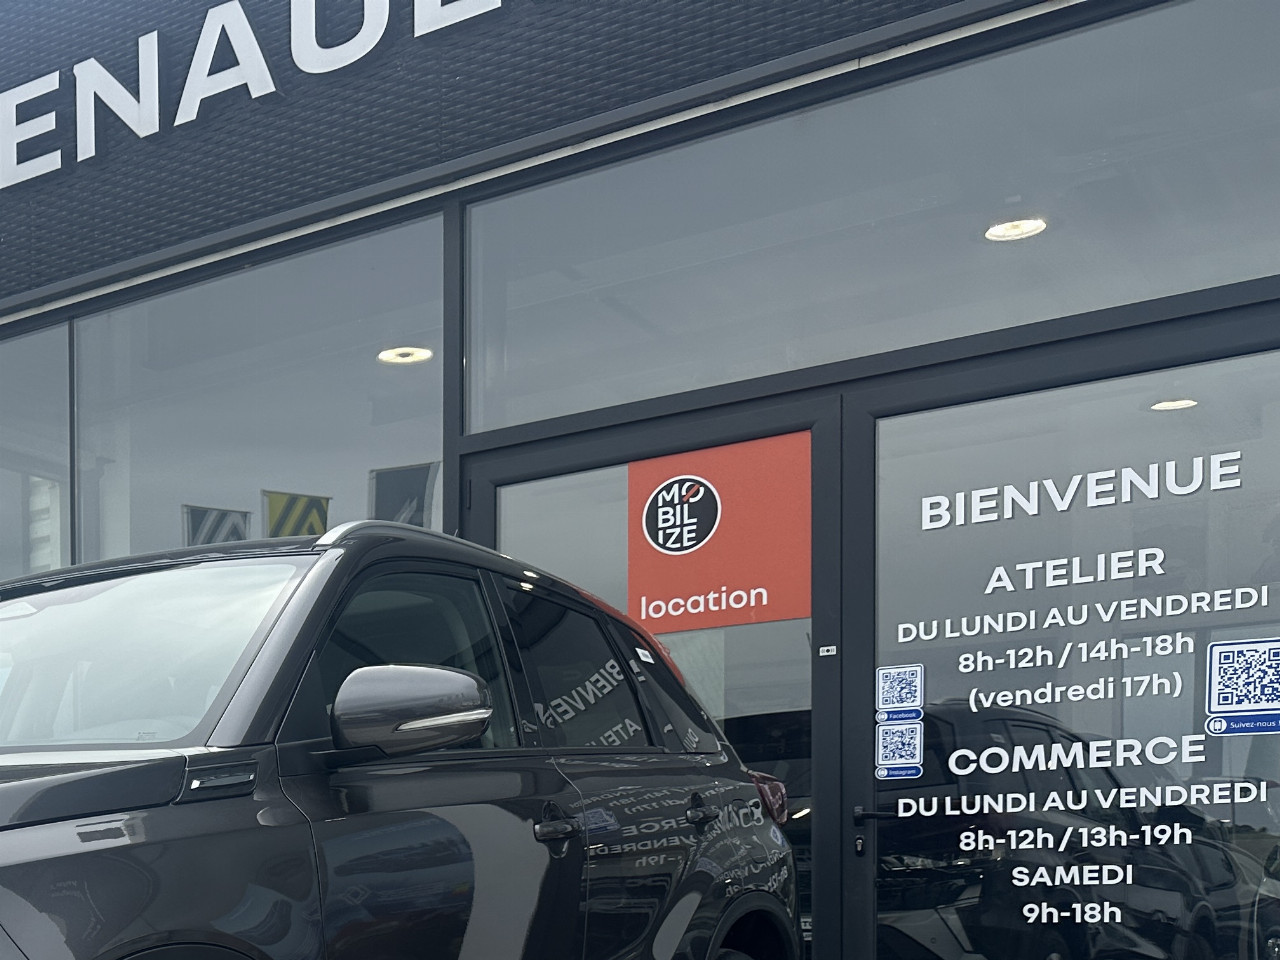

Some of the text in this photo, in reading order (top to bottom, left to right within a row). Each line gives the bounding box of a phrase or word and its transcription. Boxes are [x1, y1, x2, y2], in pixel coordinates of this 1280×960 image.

[921, 451, 1242, 531] BIENVENUE
[984, 548, 1166, 595] ATELIER
[641, 586, 769, 620] location
[897, 586, 1269, 643] DU LUNDI AU VENDREDI
[958, 643, 1053, 673] 8h-12h
[1078, 631, 1194, 664] 14h-18h
[969, 671, 1183, 713] (vendredi 17h)
[1229, 720, 1276, 729] Suivez-nous
[948, 734, 1206, 776] COMMERCE
[898, 782, 1267, 817] DU LUNDI AU VENDREDI
[959, 827, 1054, 852] 8h-12h
[1078, 822, 1193, 847] 13h-19h
[1012, 865, 1133, 888] SAMEDI
[1022, 902, 1122, 923] 9h-18h
